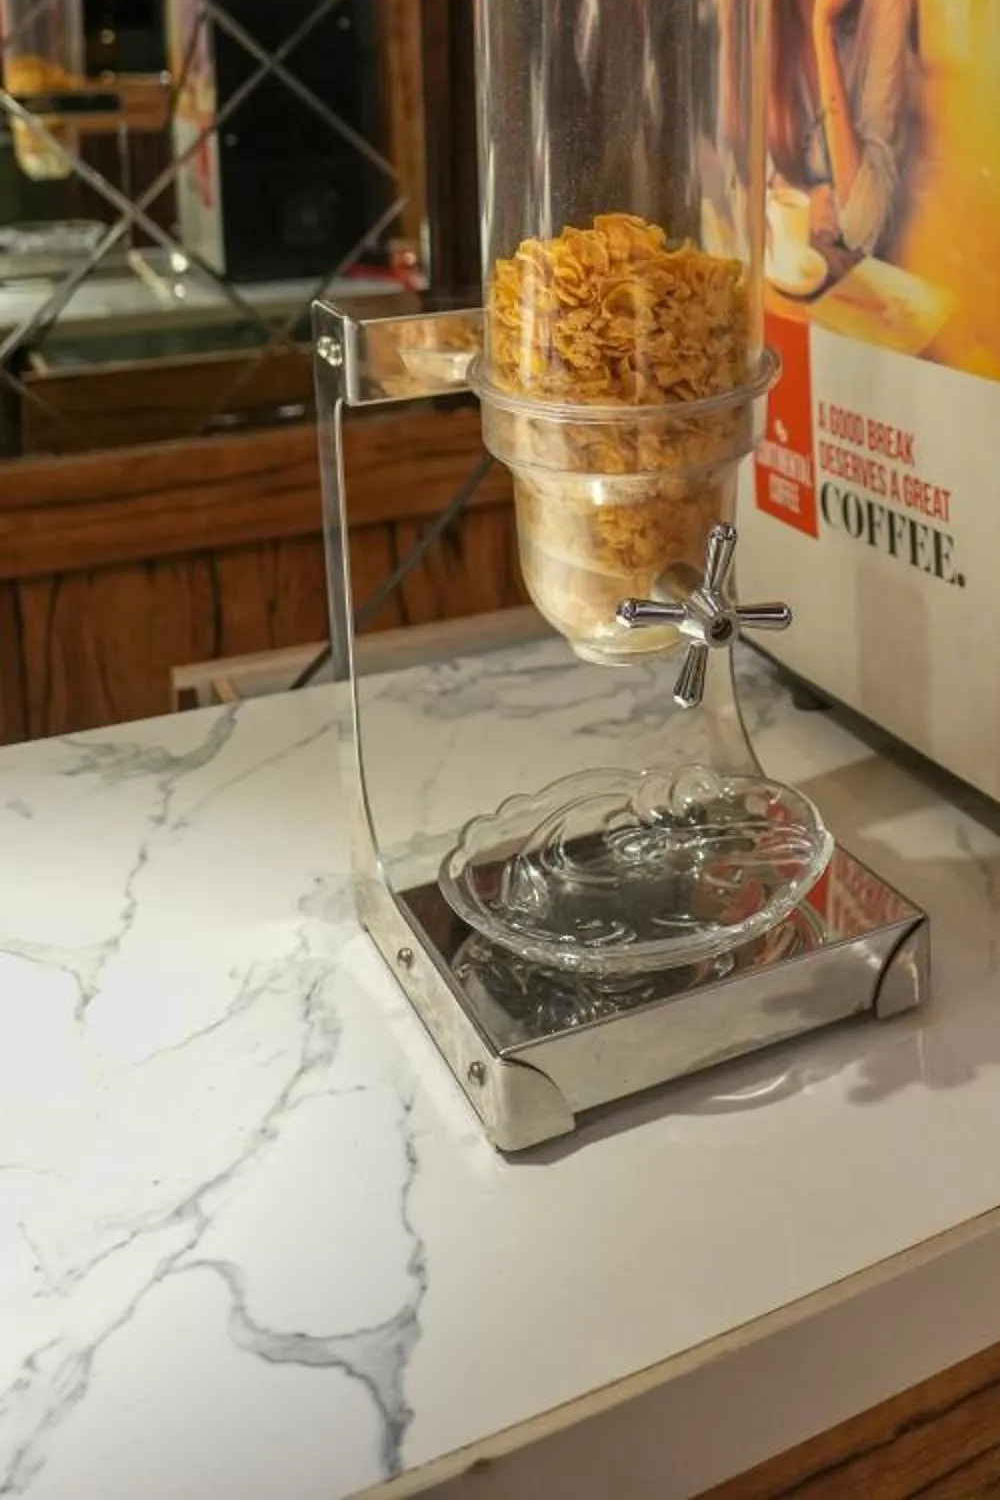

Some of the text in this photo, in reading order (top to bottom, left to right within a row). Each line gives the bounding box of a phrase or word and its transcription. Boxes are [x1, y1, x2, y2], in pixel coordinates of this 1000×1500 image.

[829, 404, 865, 446] GOOD
[818, 440, 952, 523] DESERVES A GREAT
